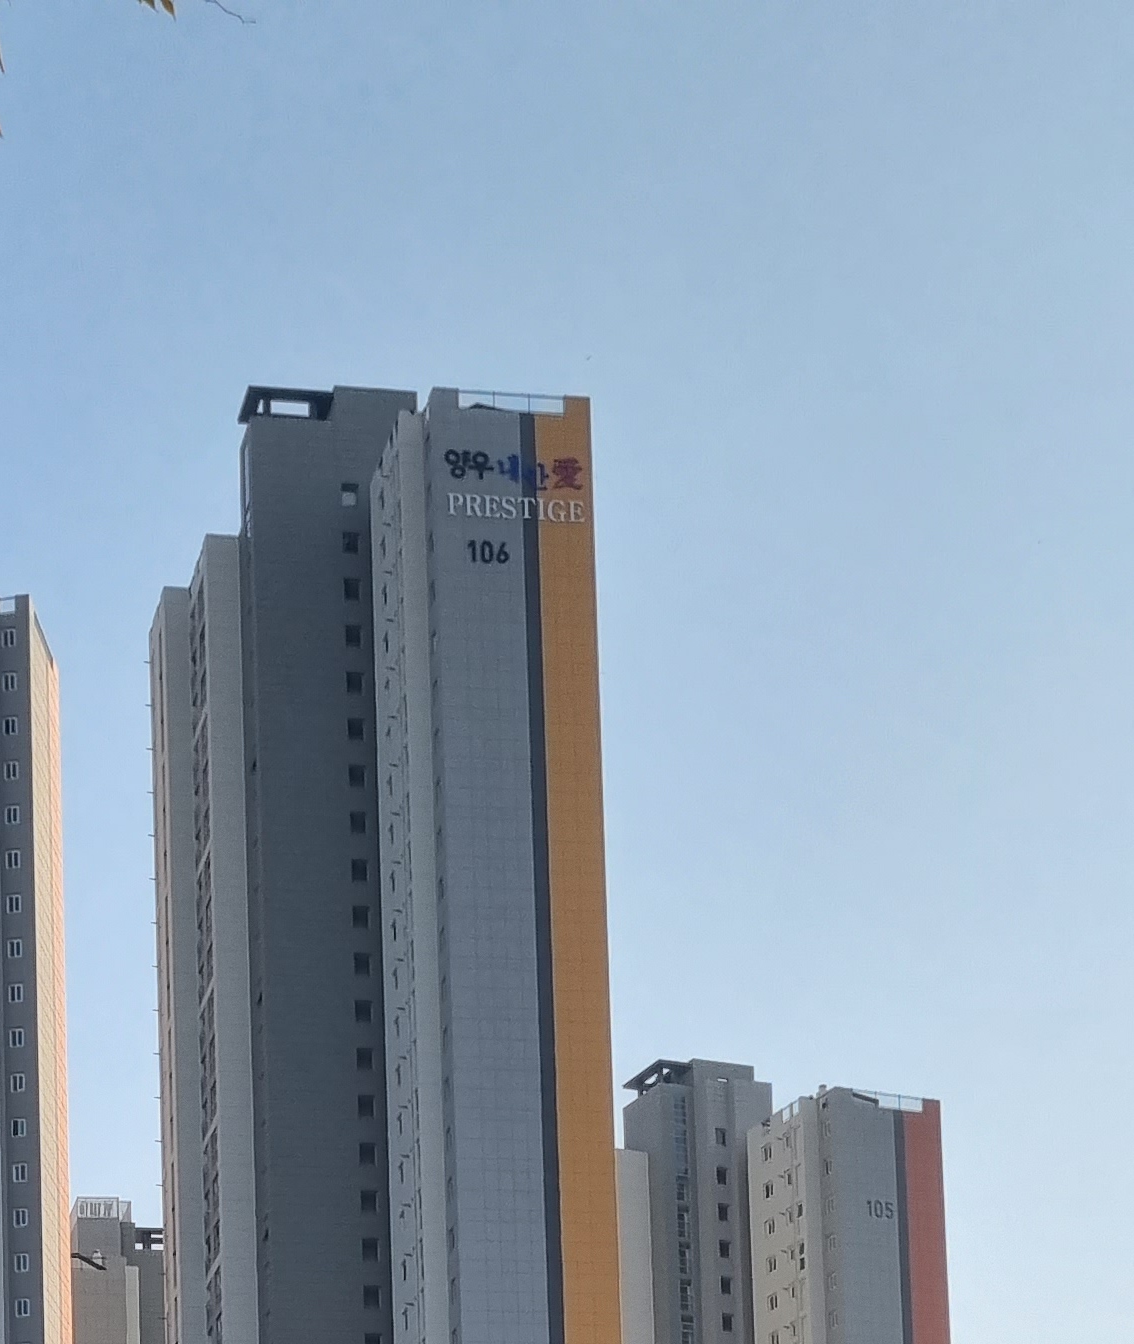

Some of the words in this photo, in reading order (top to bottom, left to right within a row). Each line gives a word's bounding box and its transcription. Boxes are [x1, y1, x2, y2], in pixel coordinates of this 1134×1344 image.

[447, 492, 585, 523] PRESTIGE
[467, 539, 510, 564] 106
[866, 1199, 894, 1219] 105
